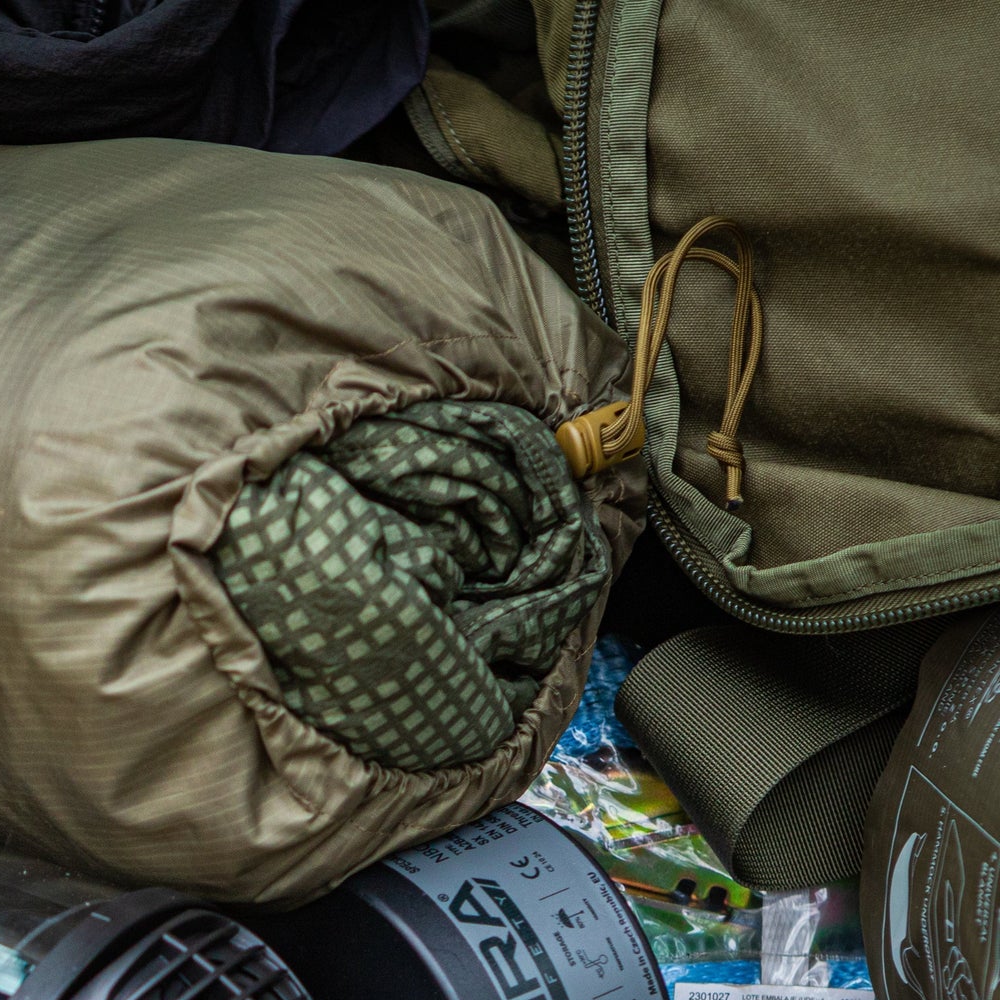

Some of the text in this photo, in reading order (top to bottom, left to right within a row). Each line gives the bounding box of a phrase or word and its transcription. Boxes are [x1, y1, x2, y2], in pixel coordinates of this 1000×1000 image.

[486, 831, 504, 841] EN
[500, 822, 518, 834] DIN
[925, 820, 944, 894] HAMMOCK
[587, 871, 600, 884] EU
[979, 867, 996, 943] UNIVERSAL
[554, 931, 576, 967] STORAGE
[624, 926, 640, 955] Czech
[643, 972, 657, 995] Made
